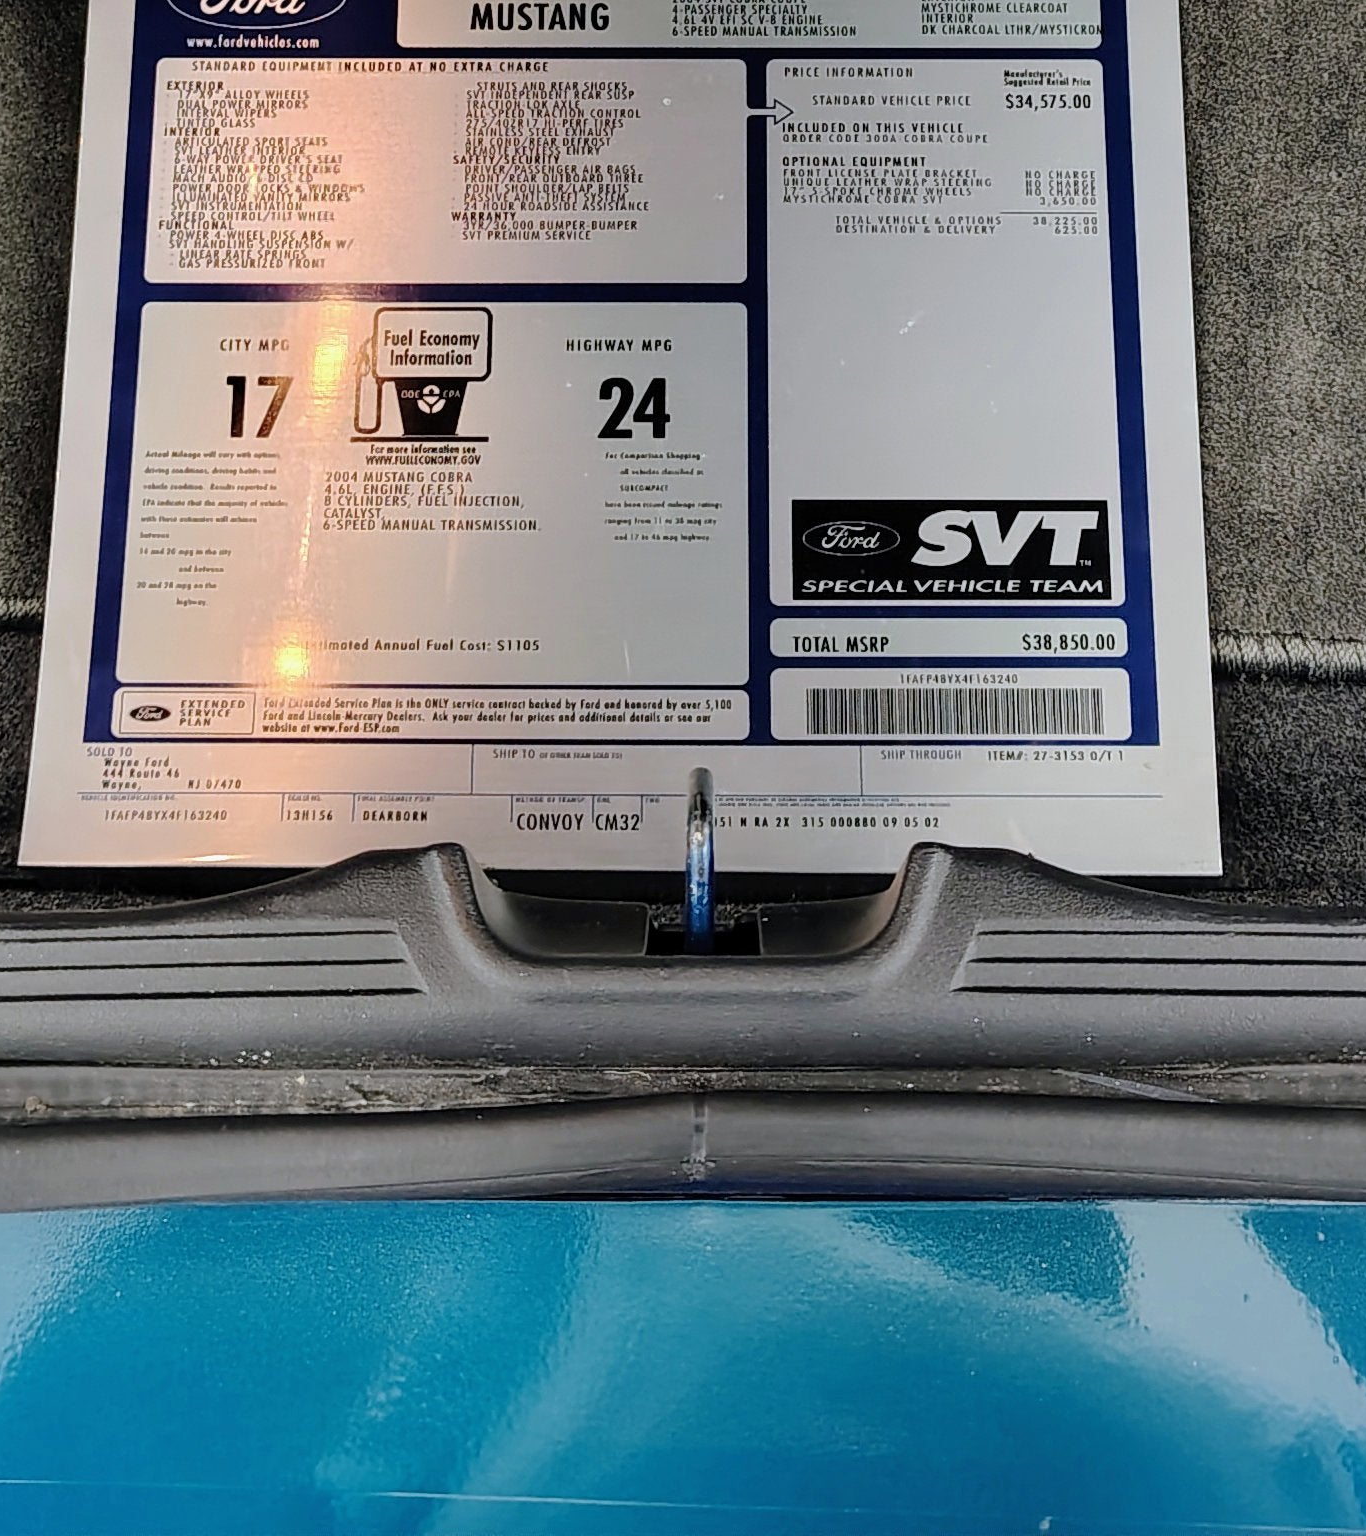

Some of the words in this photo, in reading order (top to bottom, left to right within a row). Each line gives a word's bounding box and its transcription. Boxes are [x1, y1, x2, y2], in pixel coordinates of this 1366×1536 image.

[751, 4, 808, 15] SPECIALTY
[920, 2, 1001, 14] MYSTICHROME
[1005, 2, 1067, 14] CLEARCOAT
[471, 4, 610, 31] MUSTANG
[671, 14, 696, 26] 4.6L
[719, 14, 736, 26] EFI
[758, 14, 777, 26] V-8
[782, 14, 823, 26] ENGINE
[921, 13, 974, 24] INTERIOR
[671, 25, 718, 37] 6-SPEED
[721, 25, 768, 37] MANUAL
[773, 25, 857, 37] TRANSMISSION
[941, 24, 999, 36] CHARCOAL
[191, 60, 256, 73] STANDARD
[261, 60, 331, 73] EQUIPMENT
[337, 60, 402, 73] INCLUDED
[408, 60, 422, 73] AT
[429, 60, 446, 73] NO
[453, 60, 492, 73] EXTRA
[498, 60, 548, 73] CHARGE
[783, 66, 819, 78] PRICE
[825, 66, 913, 78] INFORMATION
[166, 81, 225, 92] EXTERIOR
[811, 95, 875, 107] STANDARD
[880, 95, 930, 107] VEHICLE
[935, 95, 970, 107] PRICE
[1005, 94, 1091, 111] $34,575.00
[163, 127, 221, 137] INTERIOR
[781, 122, 846, 134] INCLUDED
[876, 122, 905, 134] THIS
[910, 122, 963, 134] VEHICLE
[452, 155, 561, 165] SAFETY/SECURITY
[781, 156, 844, 168] OPTIONAL
[851, 156, 925, 168] EQUIPMENT
[451, 211, 517, 222] WARRANTY
[219, 338, 251, 352] CITY
[258, 338, 289, 352] MPG
[384, 330, 412, 350] Fuel
[420, 330, 479, 350] Economy
[566, 338, 634, 352] HIGHWAY
[641, 338, 672, 352] MPG
[391, 350, 472, 366] Information
[227, 376, 294, 438] 17
[598, 378, 670, 438] 24
[325, 471, 358, 483] 2004
[362, 471, 425, 483] MUSTANG
[429, 471, 473, 483] COBRA
[417, 495, 449, 509] FUEL
[322, 519, 376, 532] 6-SPEED
[381, 519, 436, 532] MANUAL
[822, 524, 879, 550] Ford
[911, 510, 1099, 566] SVT
[801, 579, 908, 594] SPECIAL
[913, 579, 1021, 594] VEHICLE
[1029, 579, 1104, 594] TEAM
[374, 638, 420, 652] Annual
[425, 638, 454, 652] Fuel
[794, 636, 839, 652] TOTAL
[846, 636, 889, 652] MSRP
[1022, 634, 1115, 652] $38,850.00
[180, 699, 246, 709] EXTENDED
[135, 706, 163, 721] Ford
[180, 708, 231, 718] SERVICE
[179, 717, 212, 728] PLAN
[492, 748, 518, 760] SHIP
[880, 749, 906, 761] SHIP
[909, 749, 962, 761] THROUGH
[1033, 748, 1085, 763] 27-3153
[362, 810, 429, 822] DEARBORN
[517, 814, 584, 832] CONVOY
[596, 814, 640, 831] CM32
